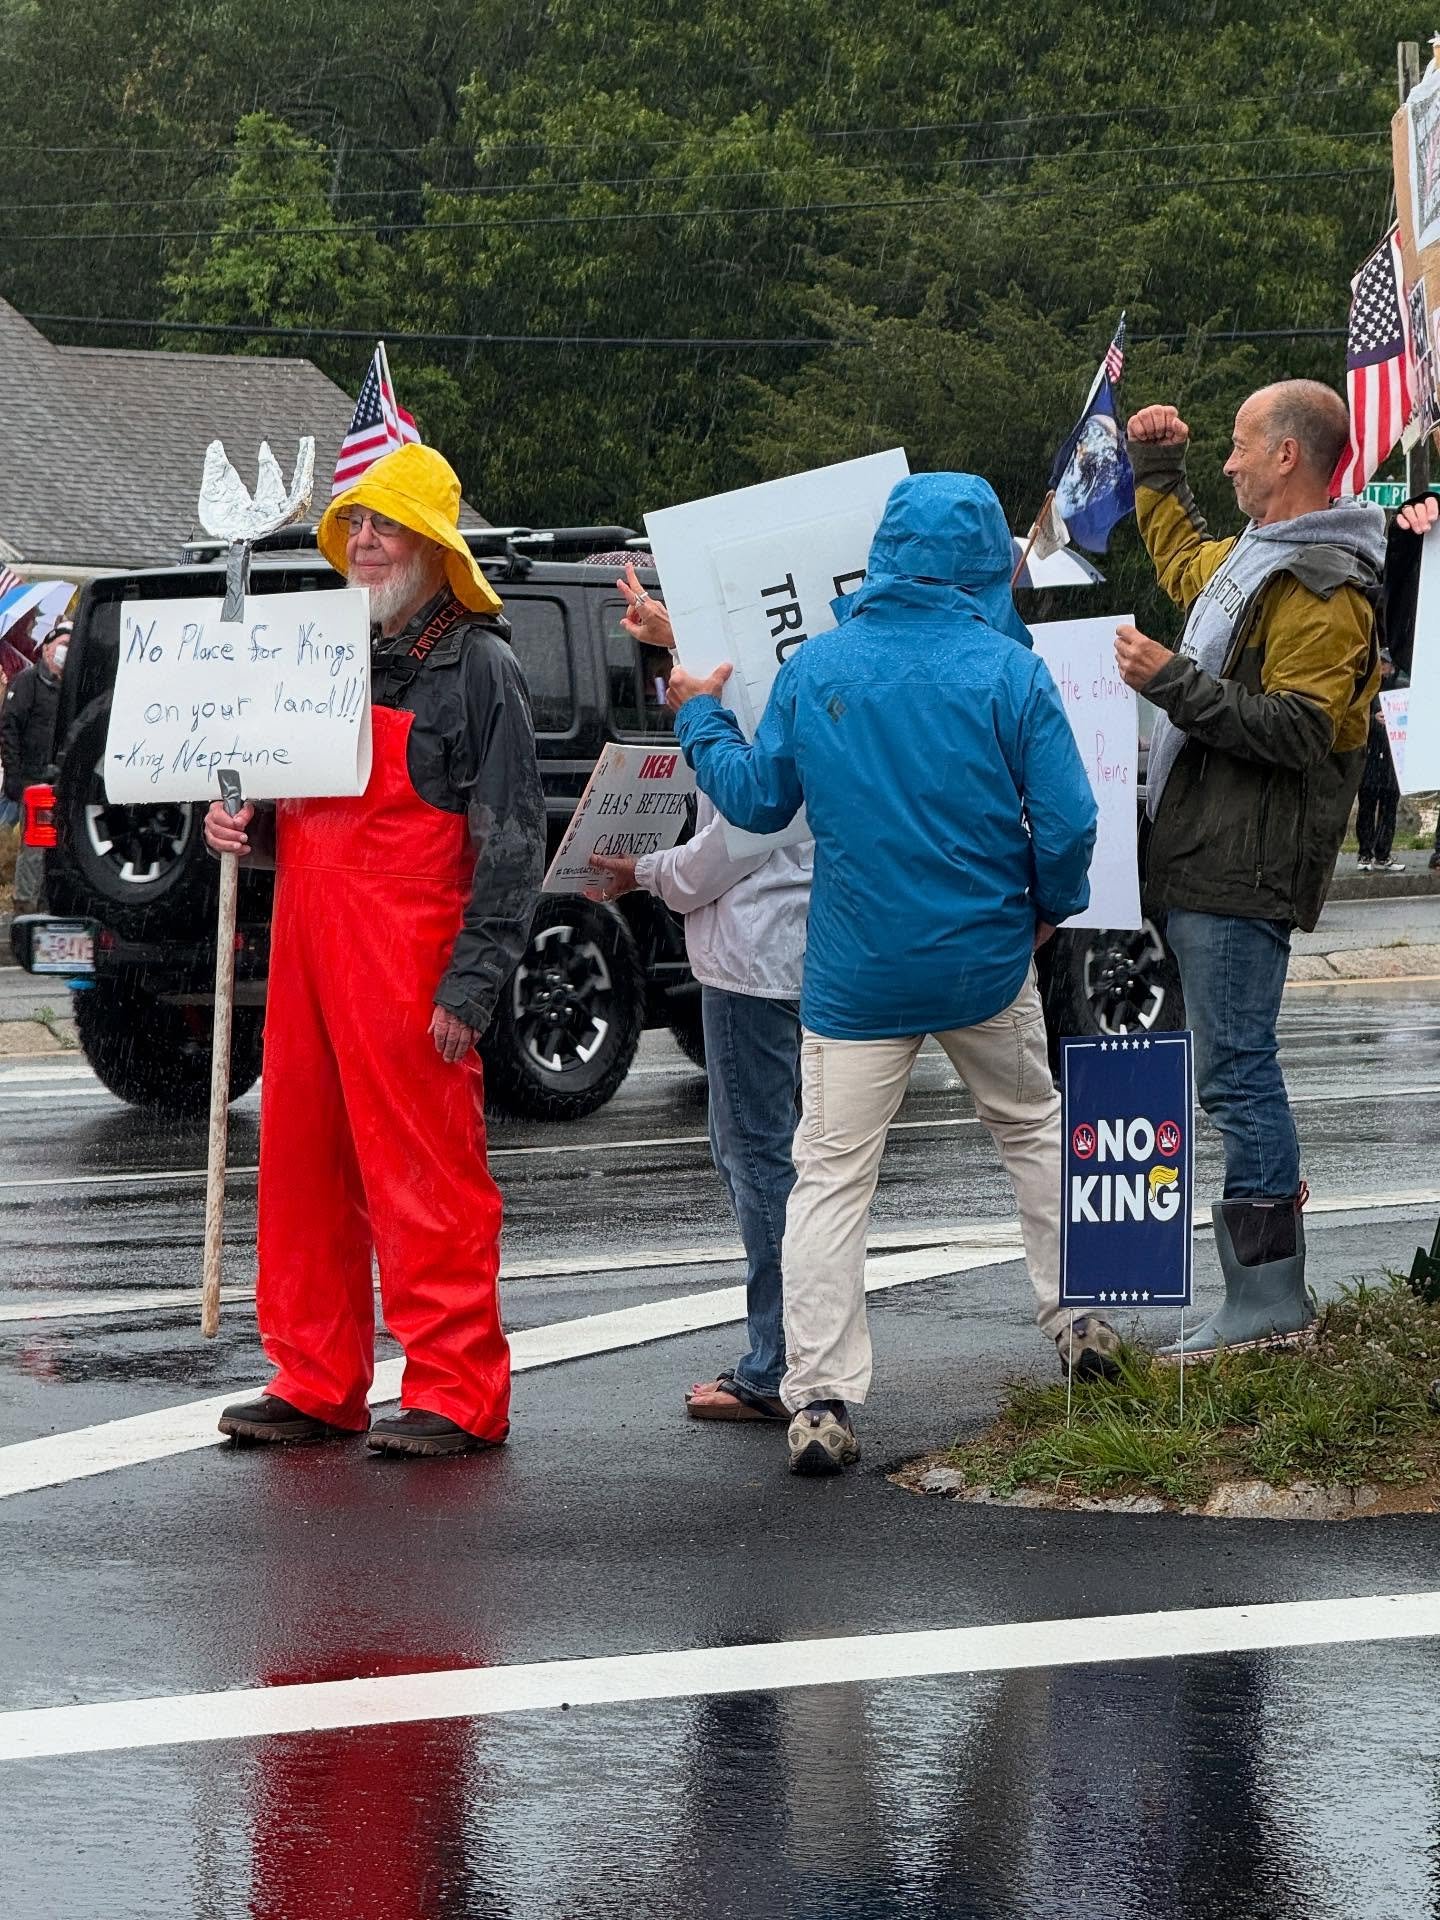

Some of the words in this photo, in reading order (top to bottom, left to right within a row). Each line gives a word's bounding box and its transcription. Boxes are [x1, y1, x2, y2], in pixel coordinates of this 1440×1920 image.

[177, 622, 235, 662] Place
[247, 624, 283, 662] for
[297, 622, 355, 677] Kings
[143, 702, 180, 724] on
[191, 696, 251, 732] your
[172, 735, 293, 783] Neptune
[638, 754, 678, 779] IKEA
[597, 793, 633, 815] HAS
[635, 792, 688, 815] BETTER
[593, 832, 662, 855] CABINETS
[1097, 1117, 1156, 1162] NO
[1071, 1173, 1181, 1222] KING
